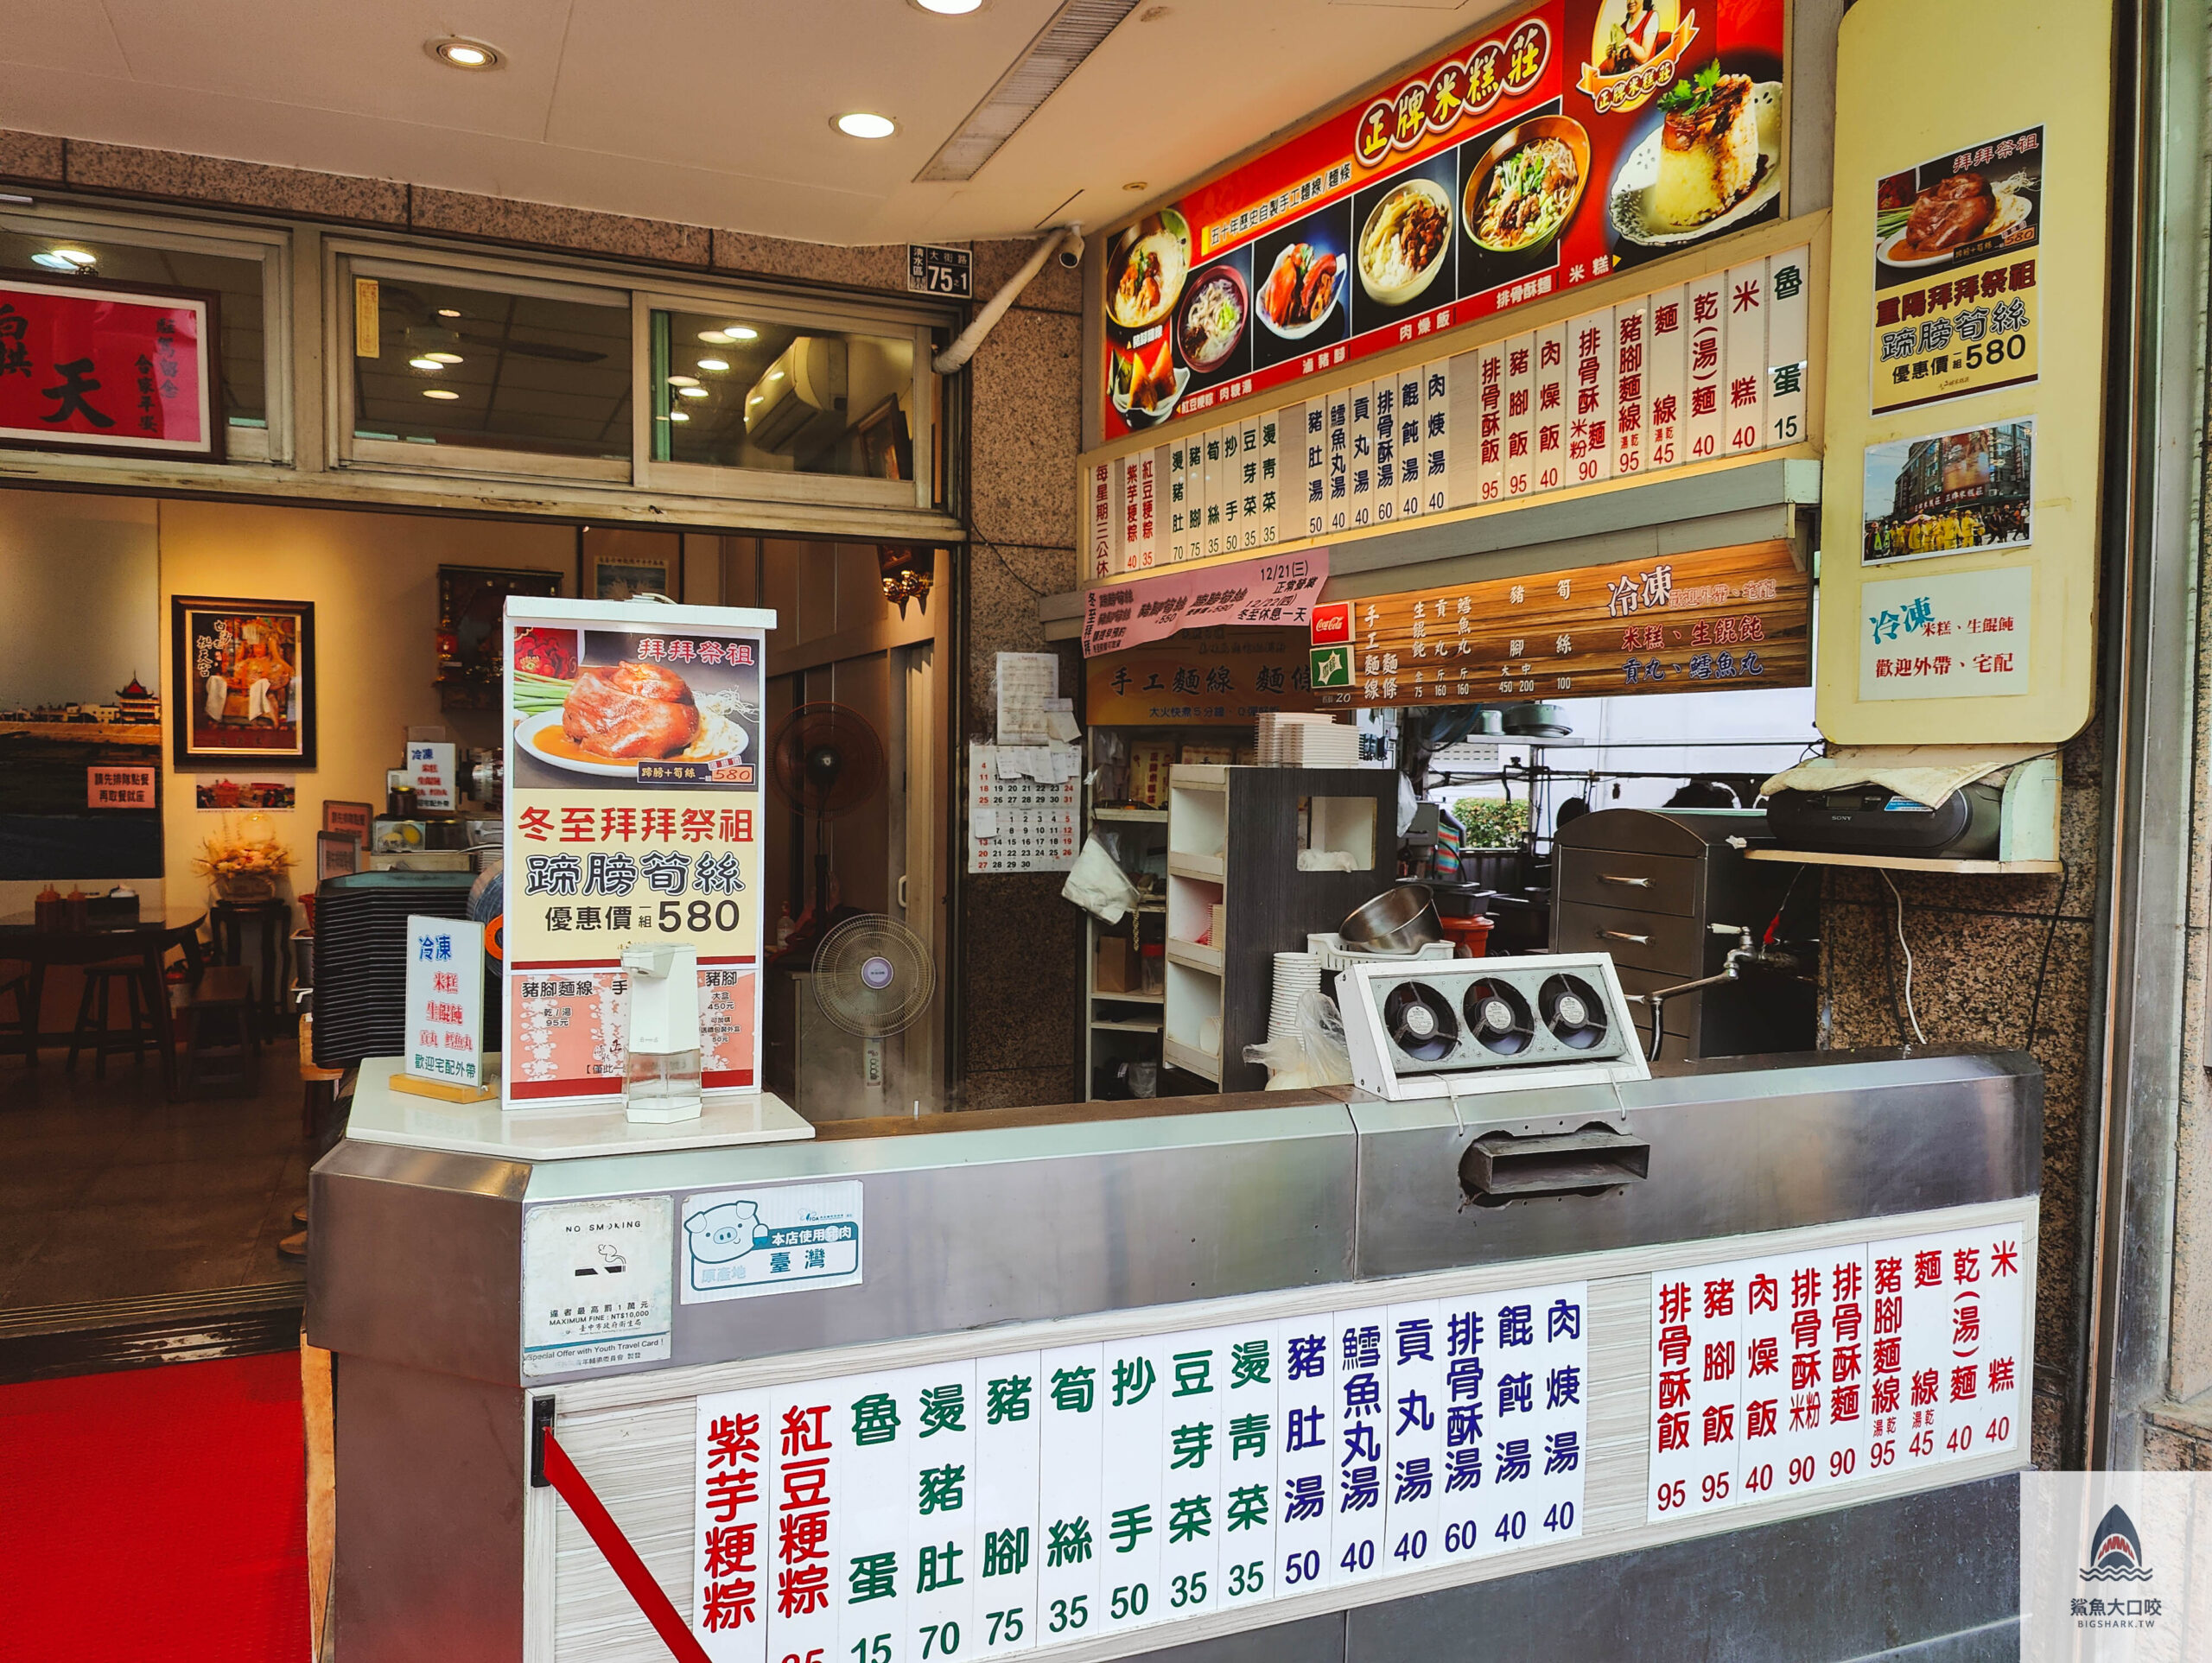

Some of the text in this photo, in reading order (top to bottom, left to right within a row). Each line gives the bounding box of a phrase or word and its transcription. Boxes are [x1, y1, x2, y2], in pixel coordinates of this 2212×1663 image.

[1363, 27, 1541, 156] 正牌米糕莊
[1953, 133, 2038, 173] 拜拜祭祖
[1399, 313, 1451, 341] 肉燥飯
[1496, 276, 1553, 310] 排骨酥麵
[1876, 259, 2036, 327] 重陽拜拜祭祖
[1880, 297, 2030, 362] 蹄膀筍絲
[39, 358, 116, 428] 天
[1618, 314, 1642, 473] 豬腳麵線 95
[1653, 302, 1679, 465] 麵線 45
[1730, 279, 1760, 449] 米糕 40
[1773, 264, 1802, 440] 魯蛋 15
[1892, 355, 1948, 384] 優惠價
[1966, 333, 2026, 369] 580
[1331, 403, 1345, 529] 鱈魚丸湯 40
[1353, 396, 1370, 524] 貢丸湯 40
[1377, 390, 1394, 519] 排骨酥湯 60
[1402, 382, 1419, 514] 餛飩湯 40
[1481, 357, 1501, 500] 排骨酥飯 95
[1509, 348, 1529, 493] 豬腳飯 95
[1539, 340, 1560, 488] 肉燥飯 40
[1692, 435, 1714, 457] 40
[1096, 465, 1109, 578] 每星期三公休
[1173, 450, 1184, 561] 燙豬肚 70
[1189, 446, 1201, 556] 豬腳 75
[1207, 441, 1220, 553] 筍絲 35
[1224, 435, 1238, 550] 抄手 50
[1243, 429, 1256, 546] 豆芽菜 35
[1262, 422, 1276, 543] 燙青菜 35
[1308, 409, 1323, 533] 豬肚湯 50
[1429, 492, 1444, 510] 40
[1578, 460, 1598, 480] 90
[1128, 555, 1137, 568] 40
[1142, 551, 1152, 566] 35
[1260, 561, 1309, 581] 12/21(三)
[1273, 575, 1319, 595] 正常營業
[1607, 565, 1672, 617] 冷凍
[639, 638, 754, 666] 拜拜祭祖
[1237, 607, 1308, 622] 冬至休息一天
[1434, 599, 1448, 657] 貢丸
[1556, 580, 1572, 690] 筍絲 100
[1622, 615, 1764, 652] 米糕、生餛飩
[1623, 651, 1763, 684] 貢丸、鱈魚丸
[1869, 596, 2014, 644] 冷凍 米糕、生餛飩
[1875, 652, 2014, 678] 歡迎外帶、宅配
[1336, 693, 1351, 702] 20
[1499, 680, 1534, 694] 450 200
[518, 806, 753, 842] 冬至拜拜祭祖
[714, 769, 750, 780] 580
[524, 850, 746, 897] 蹄膀筍絲
[545, 900, 740, 932] 優惠價 580
[419, 935, 451, 962] 冷凍
[434, 971, 458, 993] 米糕
[522, 981, 593, 998] 豬腳麵線
[706, 972, 737, 986] 豬腳
[415, 1054, 476, 1079] 歡迎宅配外帶
[426, 1000, 463, 1025] 生餛飩
[701, 1266, 746, 1283] 原產地
[770, 1248, 826, 1274] 臺灣
[528, 1352, 555, 1362] Special
[594, 1344, 615, 1353] Youth
[618, 1341, 639, 1349] Travel
[550, 1317, 586, 1326] MAXIMUM
[611, 1311, 649, 1320] NT$10,000
[1830, 1262, 1862, 1476] 排骨酥麵 90
[1870, 1256, 1902, 1468] 豬腳麵線 95
[1909, 1249, 1942, 1456] 麵線 45
[1947, 1247, 1980, 1453] 乾(湯)麵 40
[1986, 1240, 2018, 1441] 米糕 40
[1495, 1304, 1533, 1541] 餛飩湯 40
[1657, 1282, 1692, 1511] 排骨酥飯 95
[1702, 1278, 1735, 1502] 豬腳飯 95
[1745, 1273, 1779, 1493] 肉燥飯 40
[1789, 1267, 1821, 1484] 排骨酥米粉 90
[1169, 1349, 1213, 1608] 豆芽菜 35
[1228, 1340, 1271, 1596] 燙青菜 35
[1285, 1334, 1325, 1584] 豬肚湯 50
[1340, 1325, 1381, 1571] 鱈魚丸湯 40
[1395, 1318, 1433, 1561] 貢丸湯 40
[1445, 1311, 1484, 1552] 排骨酥湯 60
[702, 1412, 760, 1633] 紫芋粳粽
[778, 1405, 832, 1619] 紅豆粳粽
[849, 1393, 901, 1663] 魯蛋 15
[917, 1383, 967, 1660] 燙豬肚 70
[982, 1374, 1032, 1645] 豬腳 75
[1047, 1366, 1096, 1633] 筍絲 35
[1109, 1356, 1156, 1619] 抄手 50
[1543, 1501, 1574, 1531] 40
